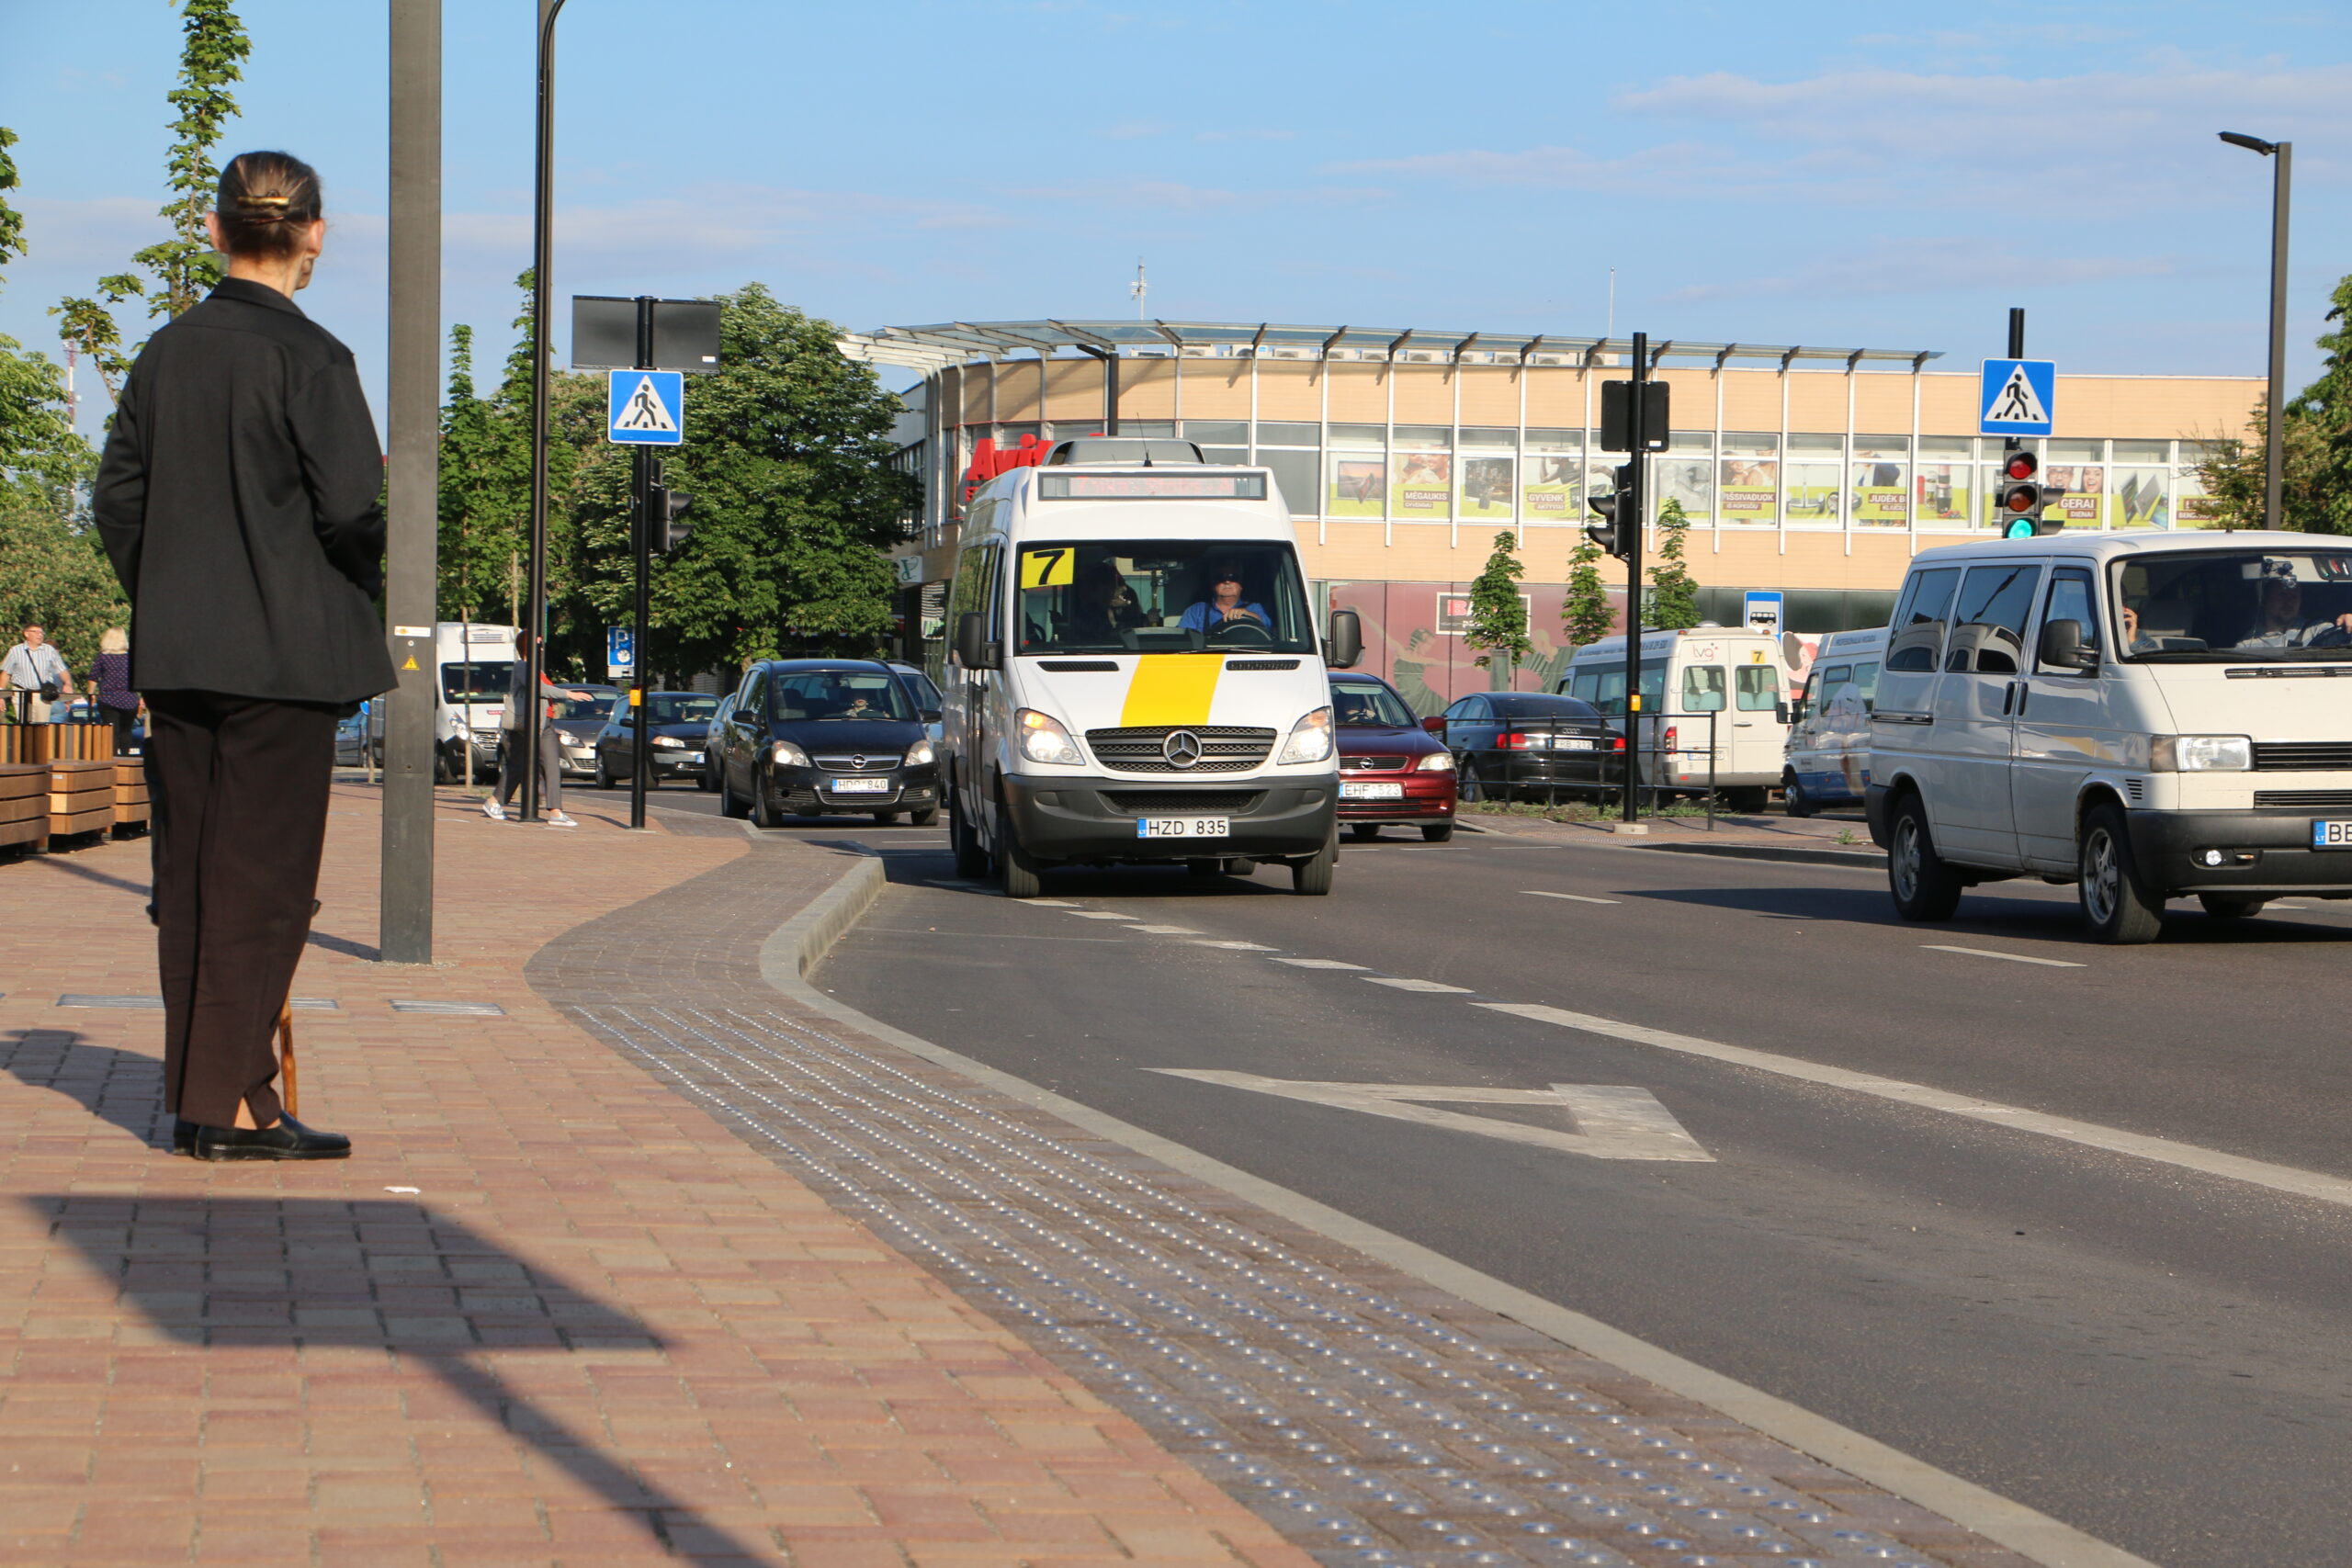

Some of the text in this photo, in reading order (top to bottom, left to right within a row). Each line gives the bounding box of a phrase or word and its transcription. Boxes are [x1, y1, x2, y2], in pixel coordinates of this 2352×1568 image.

[1405, 491, 1447, 501] MĖGAUKIS
[1528, 493, 1564, 502] GYVENK
[1870, 494, 1897, 503] JUDĖK
[2060, 498, 2095, 509] GERAI
[1033, 549, 1066, 586] 7
[615, 629, 628, 649] P
[1753, 651, 1762, 661] 7
[867, 780, 887, 789] 840
[1345, 784, 1399, 795] EHF 523
[1148, 820, 1226, 835] HZD 835
